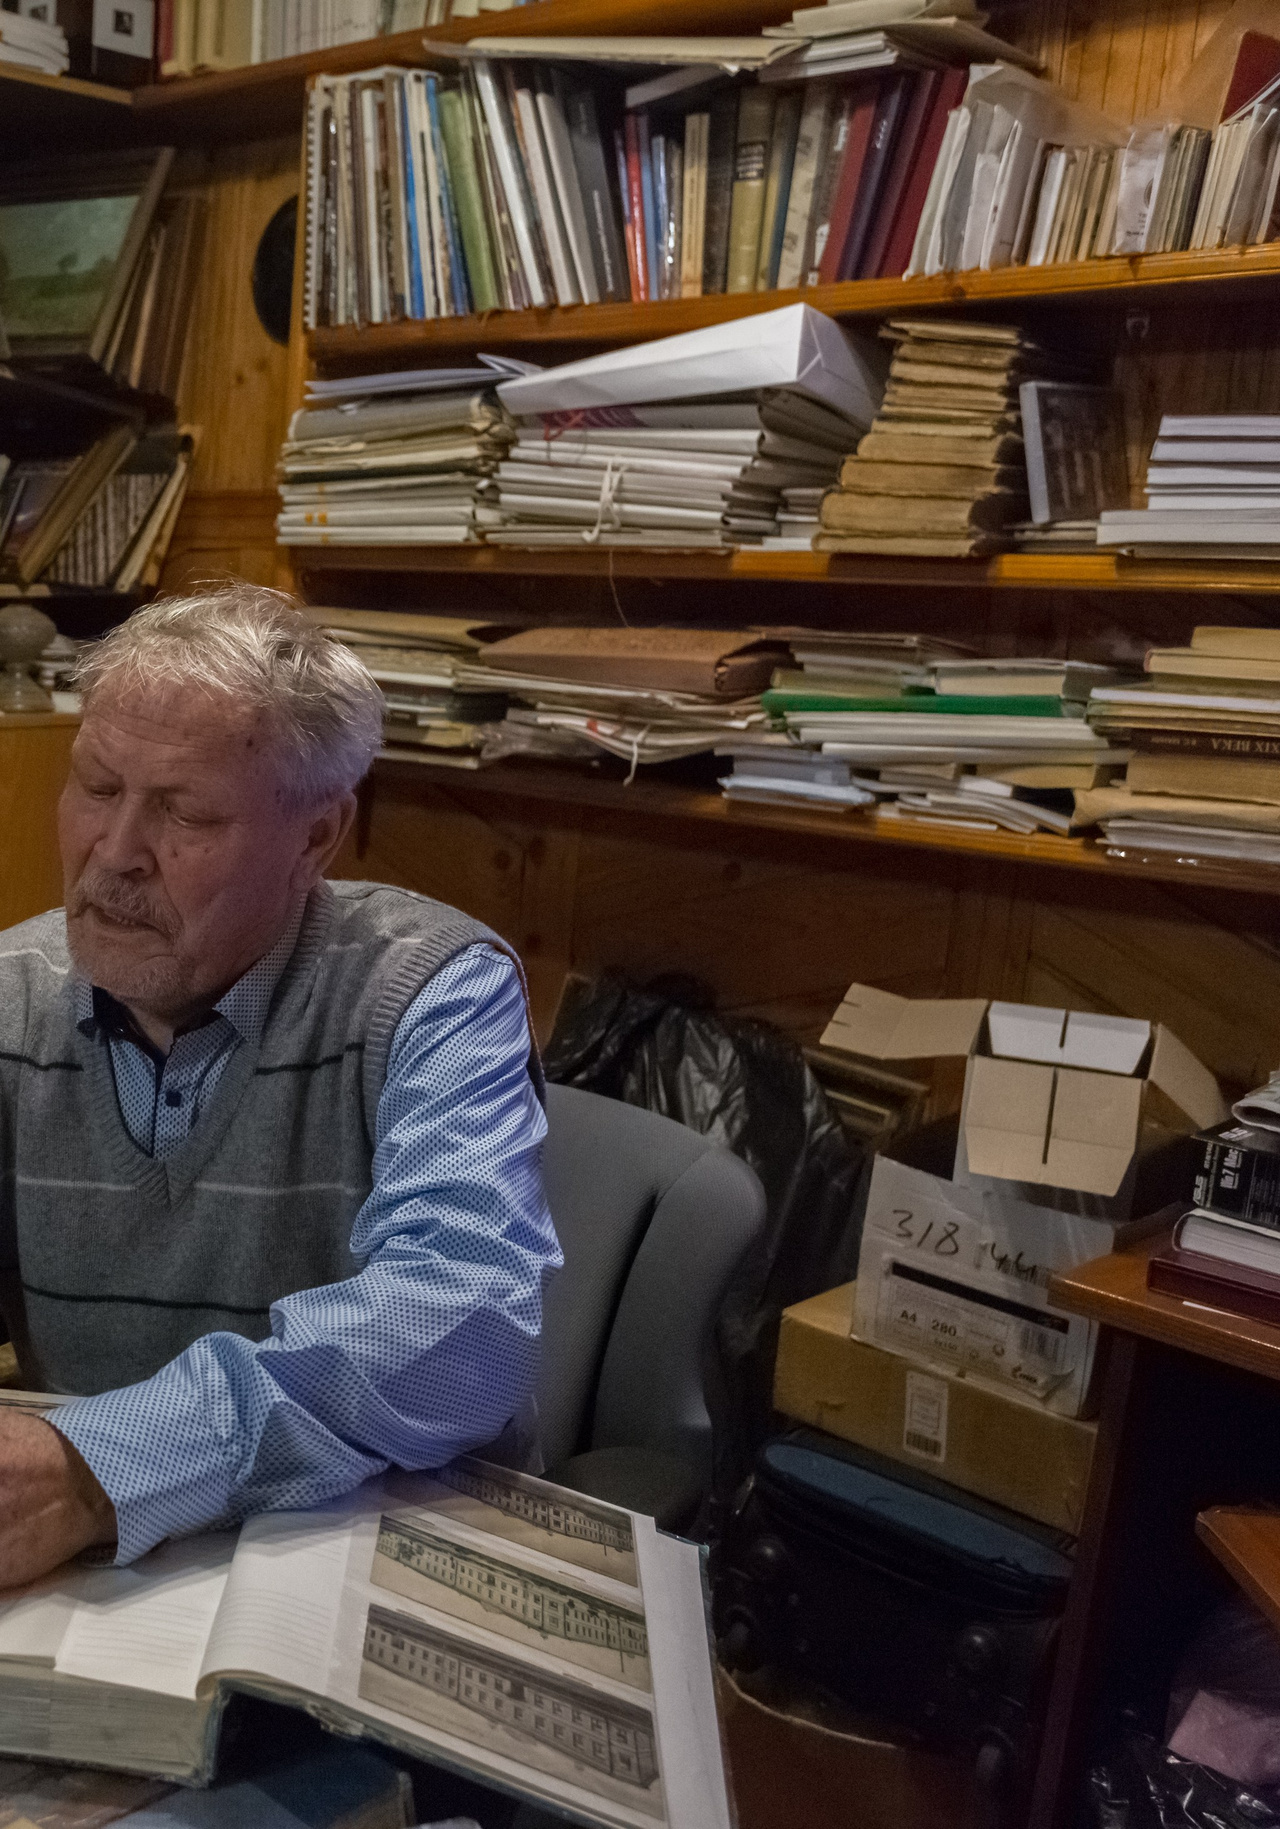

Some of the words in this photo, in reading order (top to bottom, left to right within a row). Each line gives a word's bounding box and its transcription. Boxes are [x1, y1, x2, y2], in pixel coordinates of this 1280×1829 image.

[1223, 1148, 1239, 1168] Mac
[1193, 1174, 1204, 1206] ASUS
[892, 1209, 960, 1256] 318
[900, 1309, 918, 1323] A4
[931, 1319, 957, 1338] 280
